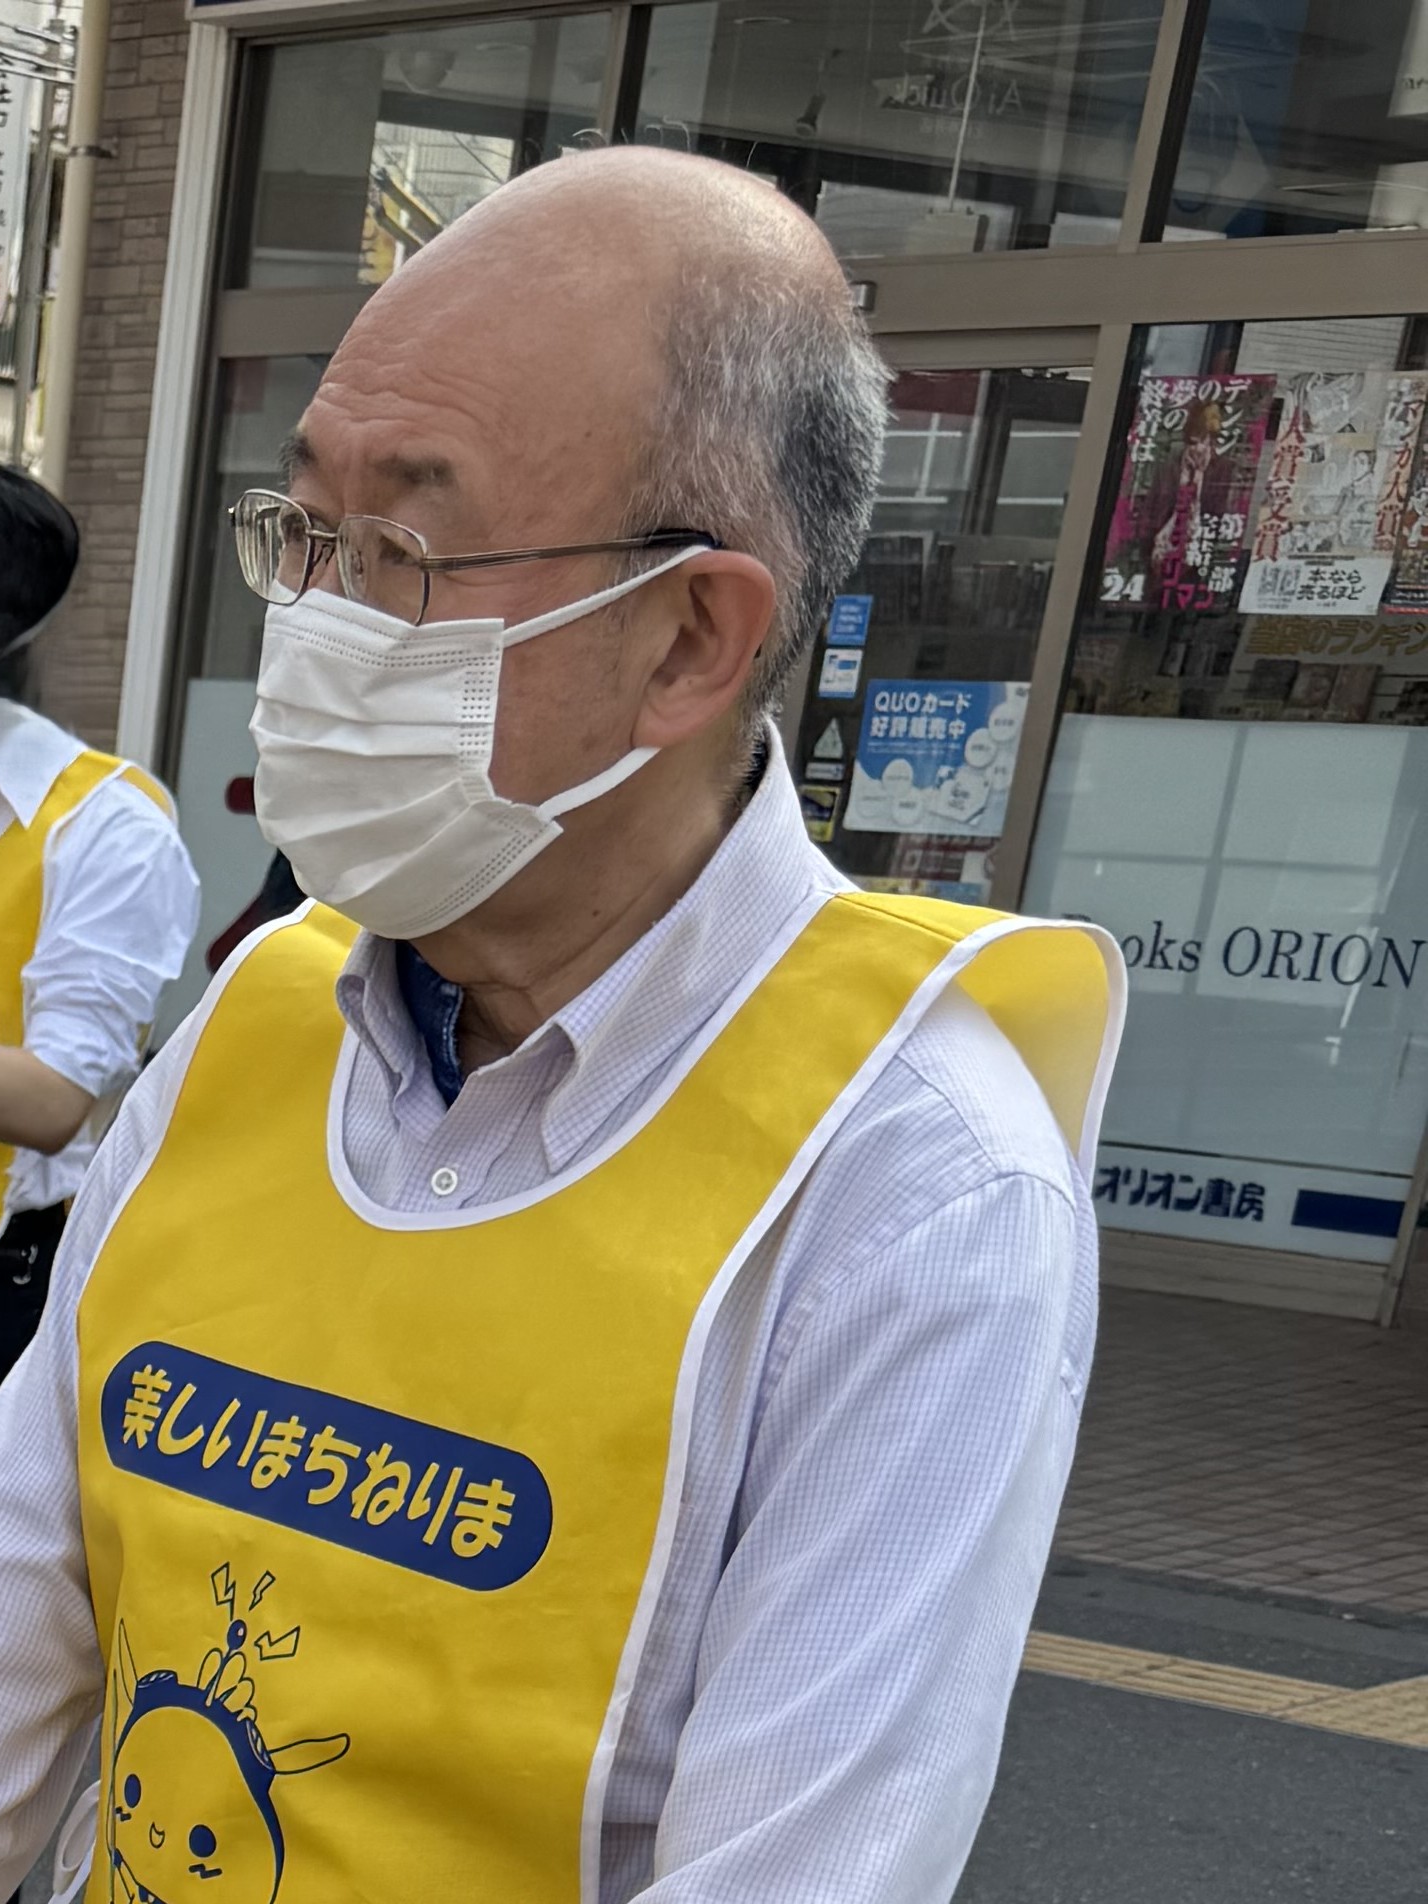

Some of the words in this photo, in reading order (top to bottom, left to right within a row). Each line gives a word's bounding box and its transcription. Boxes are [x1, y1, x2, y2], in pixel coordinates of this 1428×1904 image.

[874, 691, 972, 715] QUOカード
[1222, 925, 1428, 990] ORION
[1093, 1165, 1266, 1223] オリオン書房
[121, 1364, 516, 1560] 美しいまちねりま
